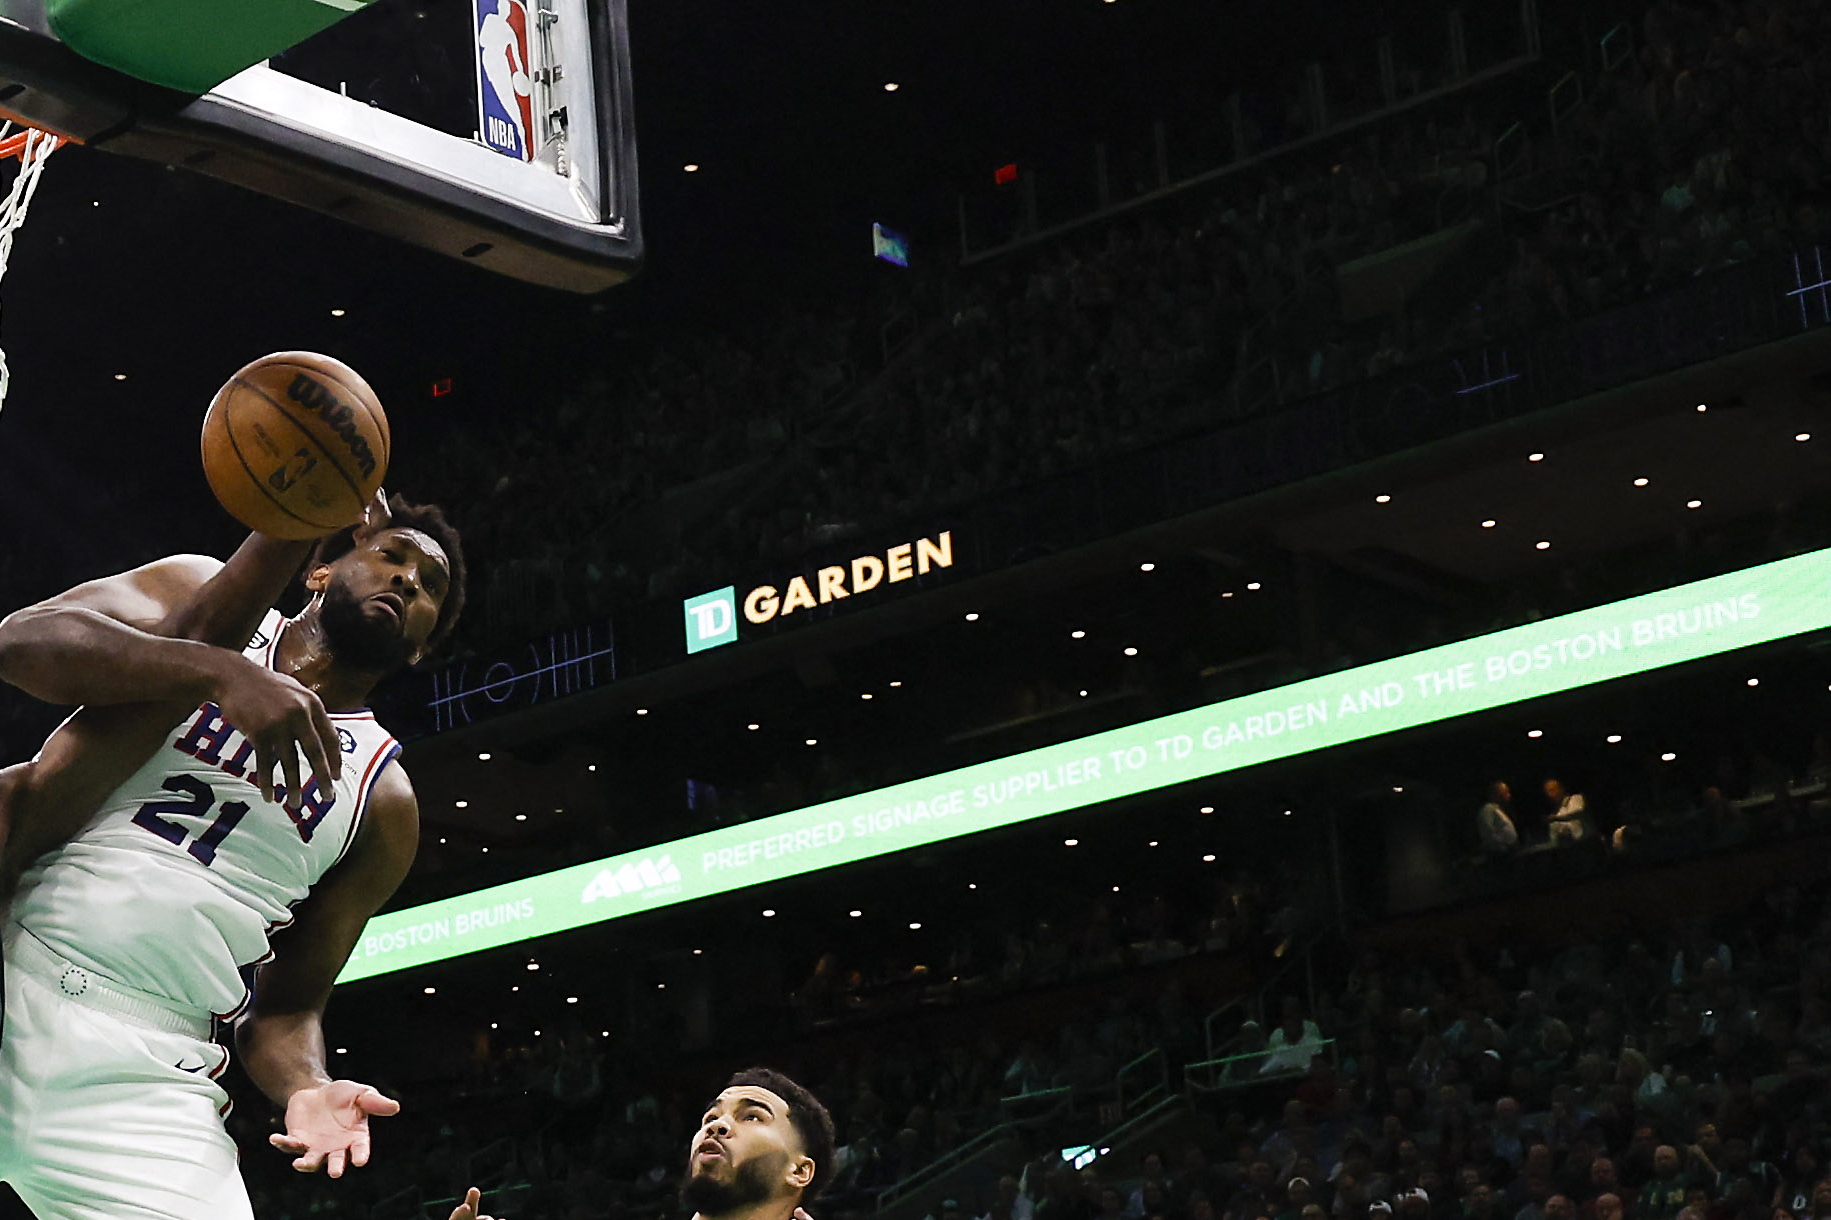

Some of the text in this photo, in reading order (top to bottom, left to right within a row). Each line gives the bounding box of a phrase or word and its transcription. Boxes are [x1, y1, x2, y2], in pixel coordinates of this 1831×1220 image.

[488, 116, 517, 152] NBA
[286, 373, 376, 480] Wilson
[743, 530, 954, 624] GARDEN
[702, 820, 845, 875] PREFERRED
[853, 789, 966, 839] SIGNAGE
[972, 756, 1102, 809] SUPPLIER
[1108, 745, 1148, 772] TO
[1154, 734, 1194, 762] TD
[1201, 698, 1329, 751] GARDEN
[1336, 681, 1405, 719] AND
[1412, 662, 1476, 699] THE
[1484, 626, 1624, 683] BOSTON
[1632, 593, 1762, 647] BRUINS
[130, 773, 251, 868] 21
[363, 919, 451, 957] BOSTON
[455, 898, 535, 936] BRUINS
